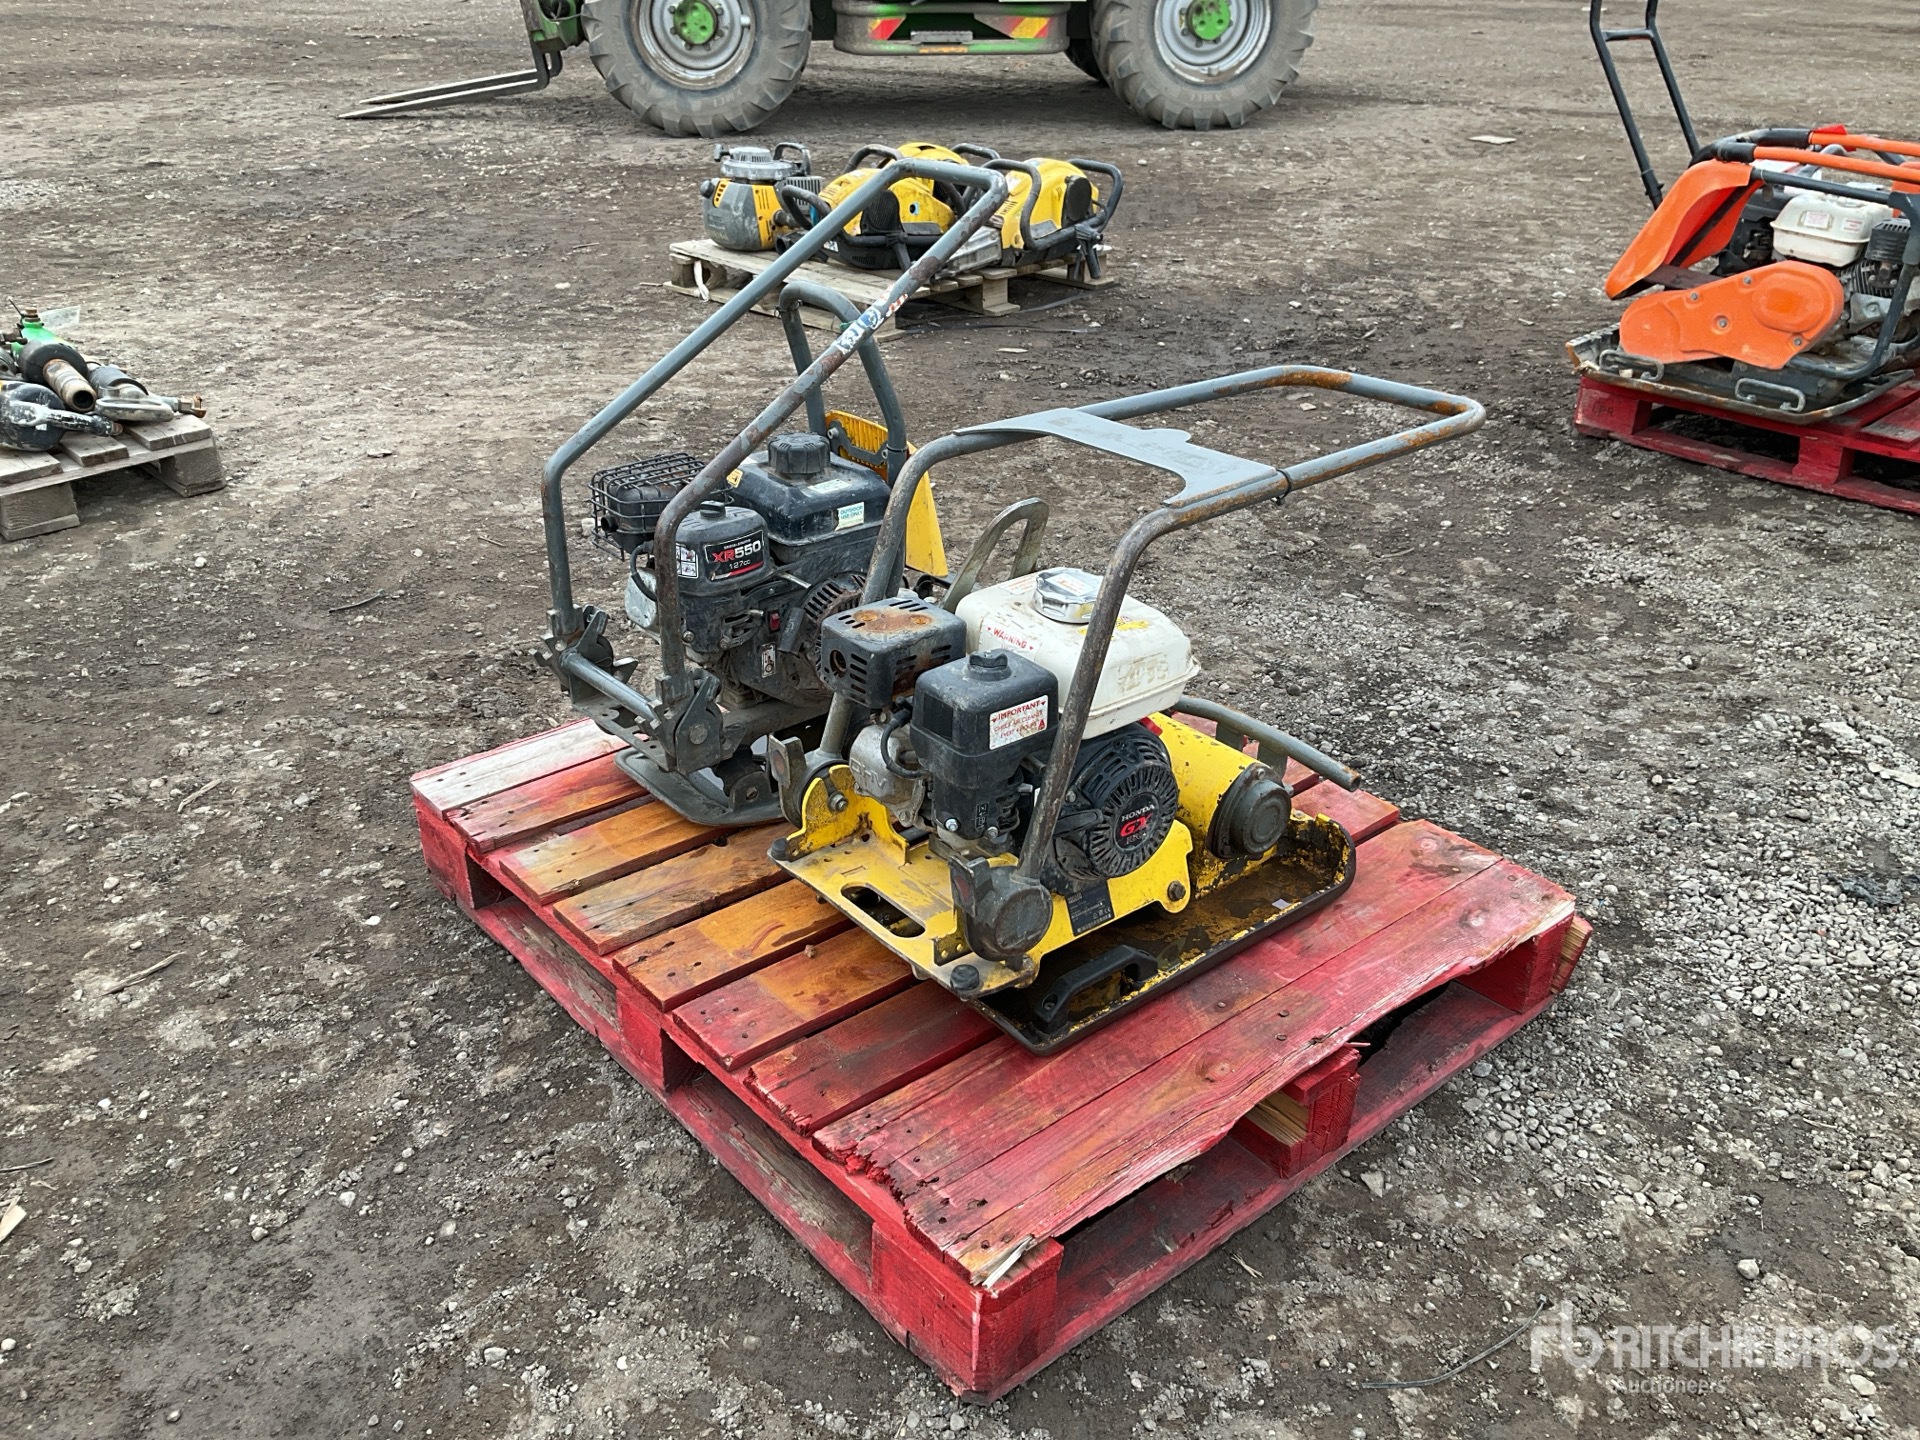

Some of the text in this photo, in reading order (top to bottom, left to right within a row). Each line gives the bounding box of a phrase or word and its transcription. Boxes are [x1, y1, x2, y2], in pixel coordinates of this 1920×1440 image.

[712, 540, 761, 563] XR550
[729, 559, 751, 569] 127cc
[993, 627, 1027, 649] WARNING
[998, 700, 1040, 720] IMPORTANT
[1120, 804, 1155, 822] HONDA
[1119, 811, 1153, 838] GX
